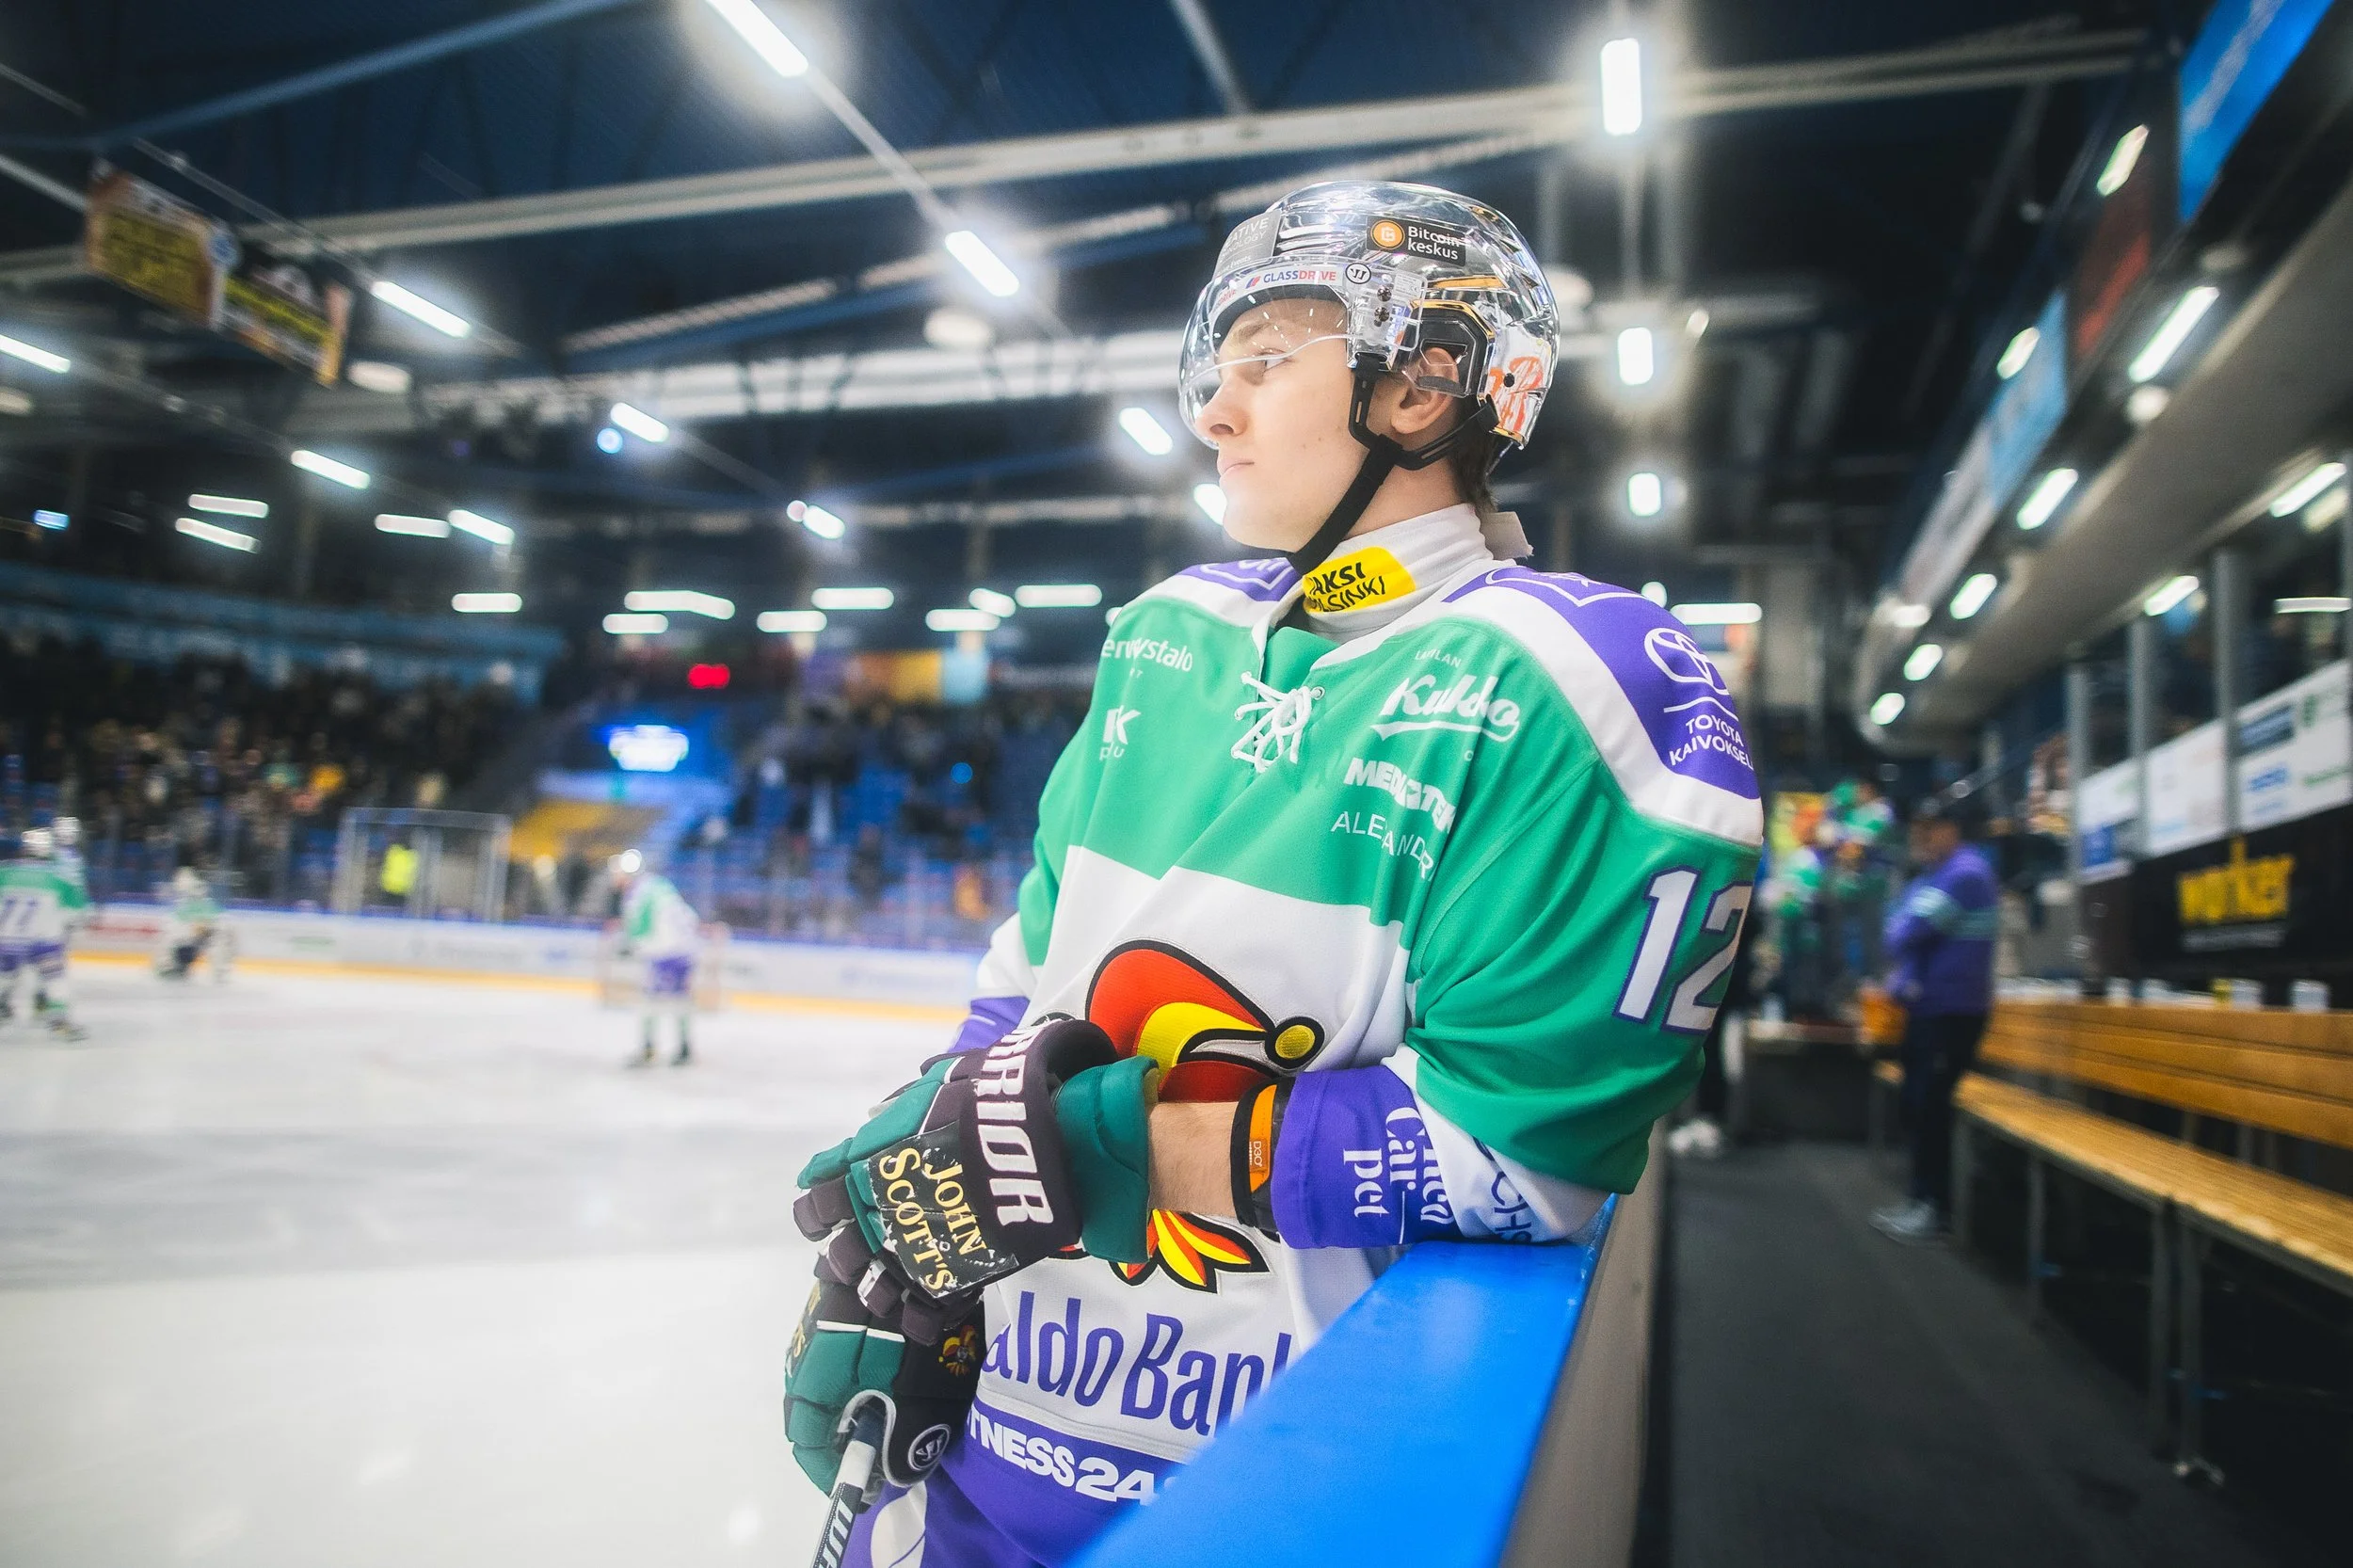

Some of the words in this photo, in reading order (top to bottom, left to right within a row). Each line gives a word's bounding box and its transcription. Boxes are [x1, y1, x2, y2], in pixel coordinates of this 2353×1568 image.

[1408, 226, 1460, 247] Bitcoin
[1408, 238, 1458, 260] keskus
[1263, 270, 1337, 283] GLASSDRVE
[1668, 734, 1754, 771] KAIVOKSEL
[1685, 714, 1744, 746] TOYOTA
[1330, 810, 1437, 882] ALEANDR
[1612, 864, 1754, 1034] 12
[878, 1147, 958, 1290] SCOTT'S
[923, 1163, 987, 1256] JOHN
[1342, 1146, 1390, 1219] pet
[981, 1290, 1124, 1408] aldo
